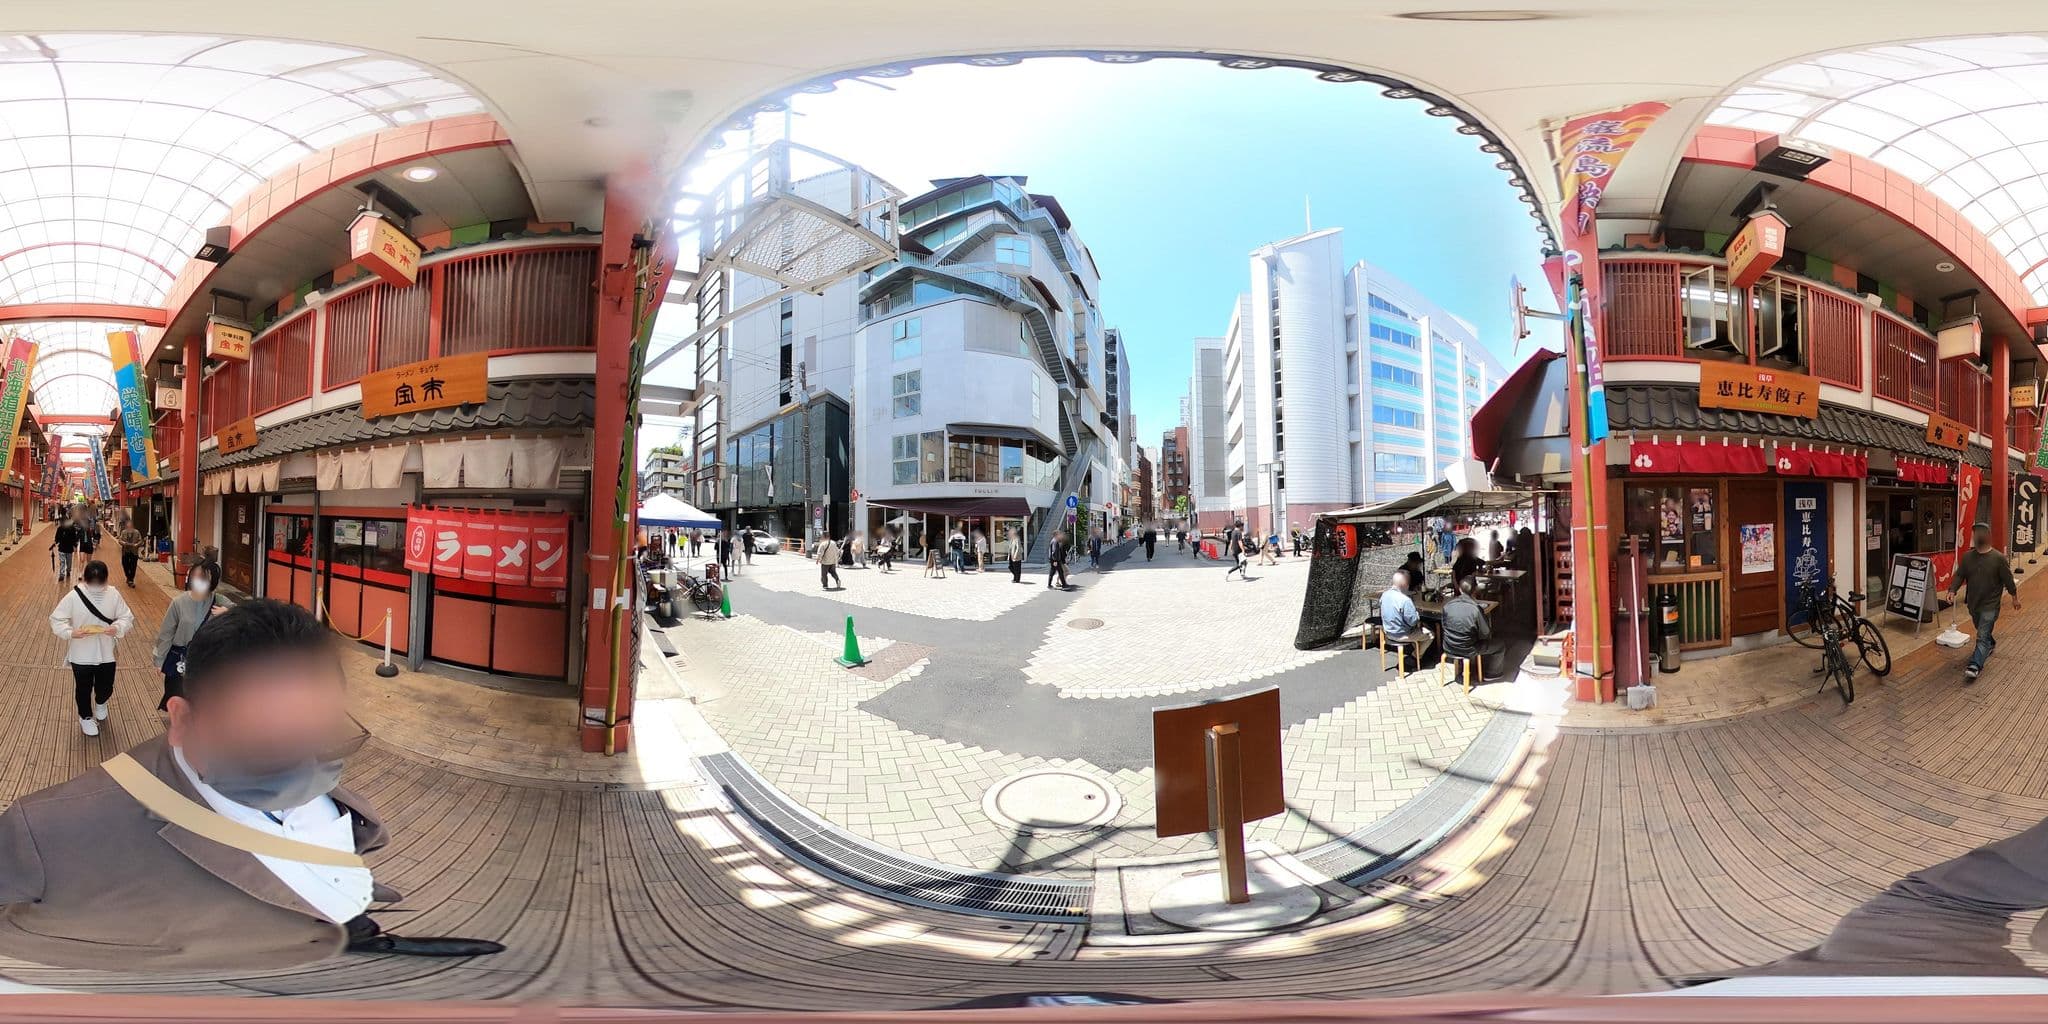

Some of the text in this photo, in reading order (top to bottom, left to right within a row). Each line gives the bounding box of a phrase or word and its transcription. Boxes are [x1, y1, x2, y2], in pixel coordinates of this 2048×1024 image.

[1717, 380, 1807, 405] 恵比寿餃子
[1801, 511, 1812, 548] 恵比寿
[2015, 481, 2038, 545] つけ麺
[436, 530, 563, 572] ラーメン
